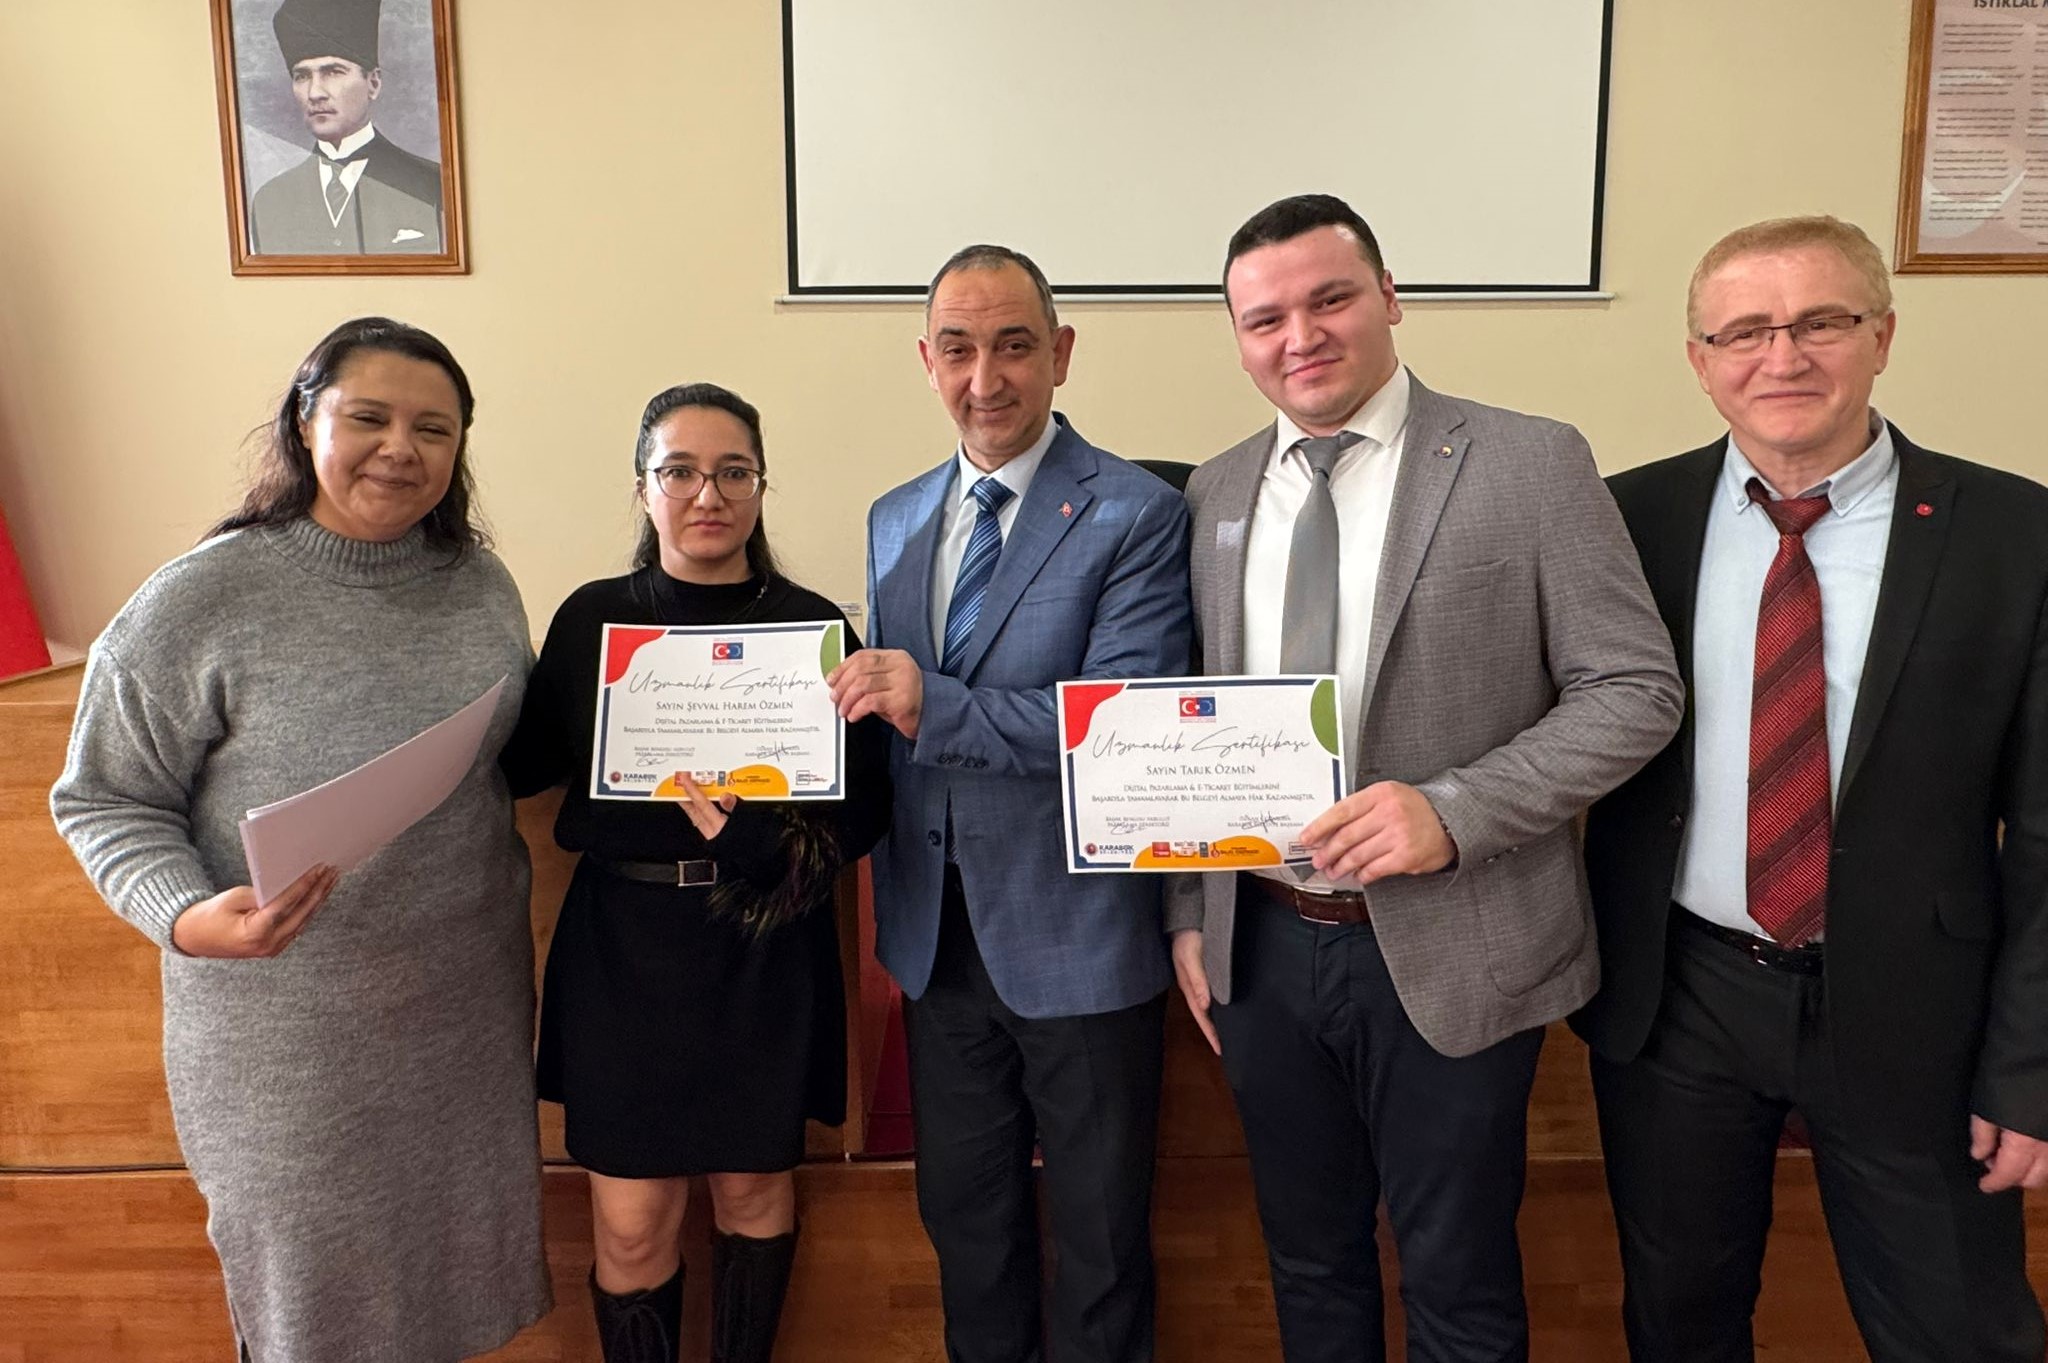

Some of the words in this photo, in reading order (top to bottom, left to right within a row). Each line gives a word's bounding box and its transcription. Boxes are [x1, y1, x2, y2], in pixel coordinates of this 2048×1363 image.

[629, 669, 715, 693] Uzmanlık
[720, 667, 817, 696] Sertifikası
[687, 702, 719, 712] ŞEVVAL
[723, 701, 756, 710] HAREM
[1093, 730, 1184, 758] Uzmanlık
[1191, 726, 1310, 758] Sertifikası
